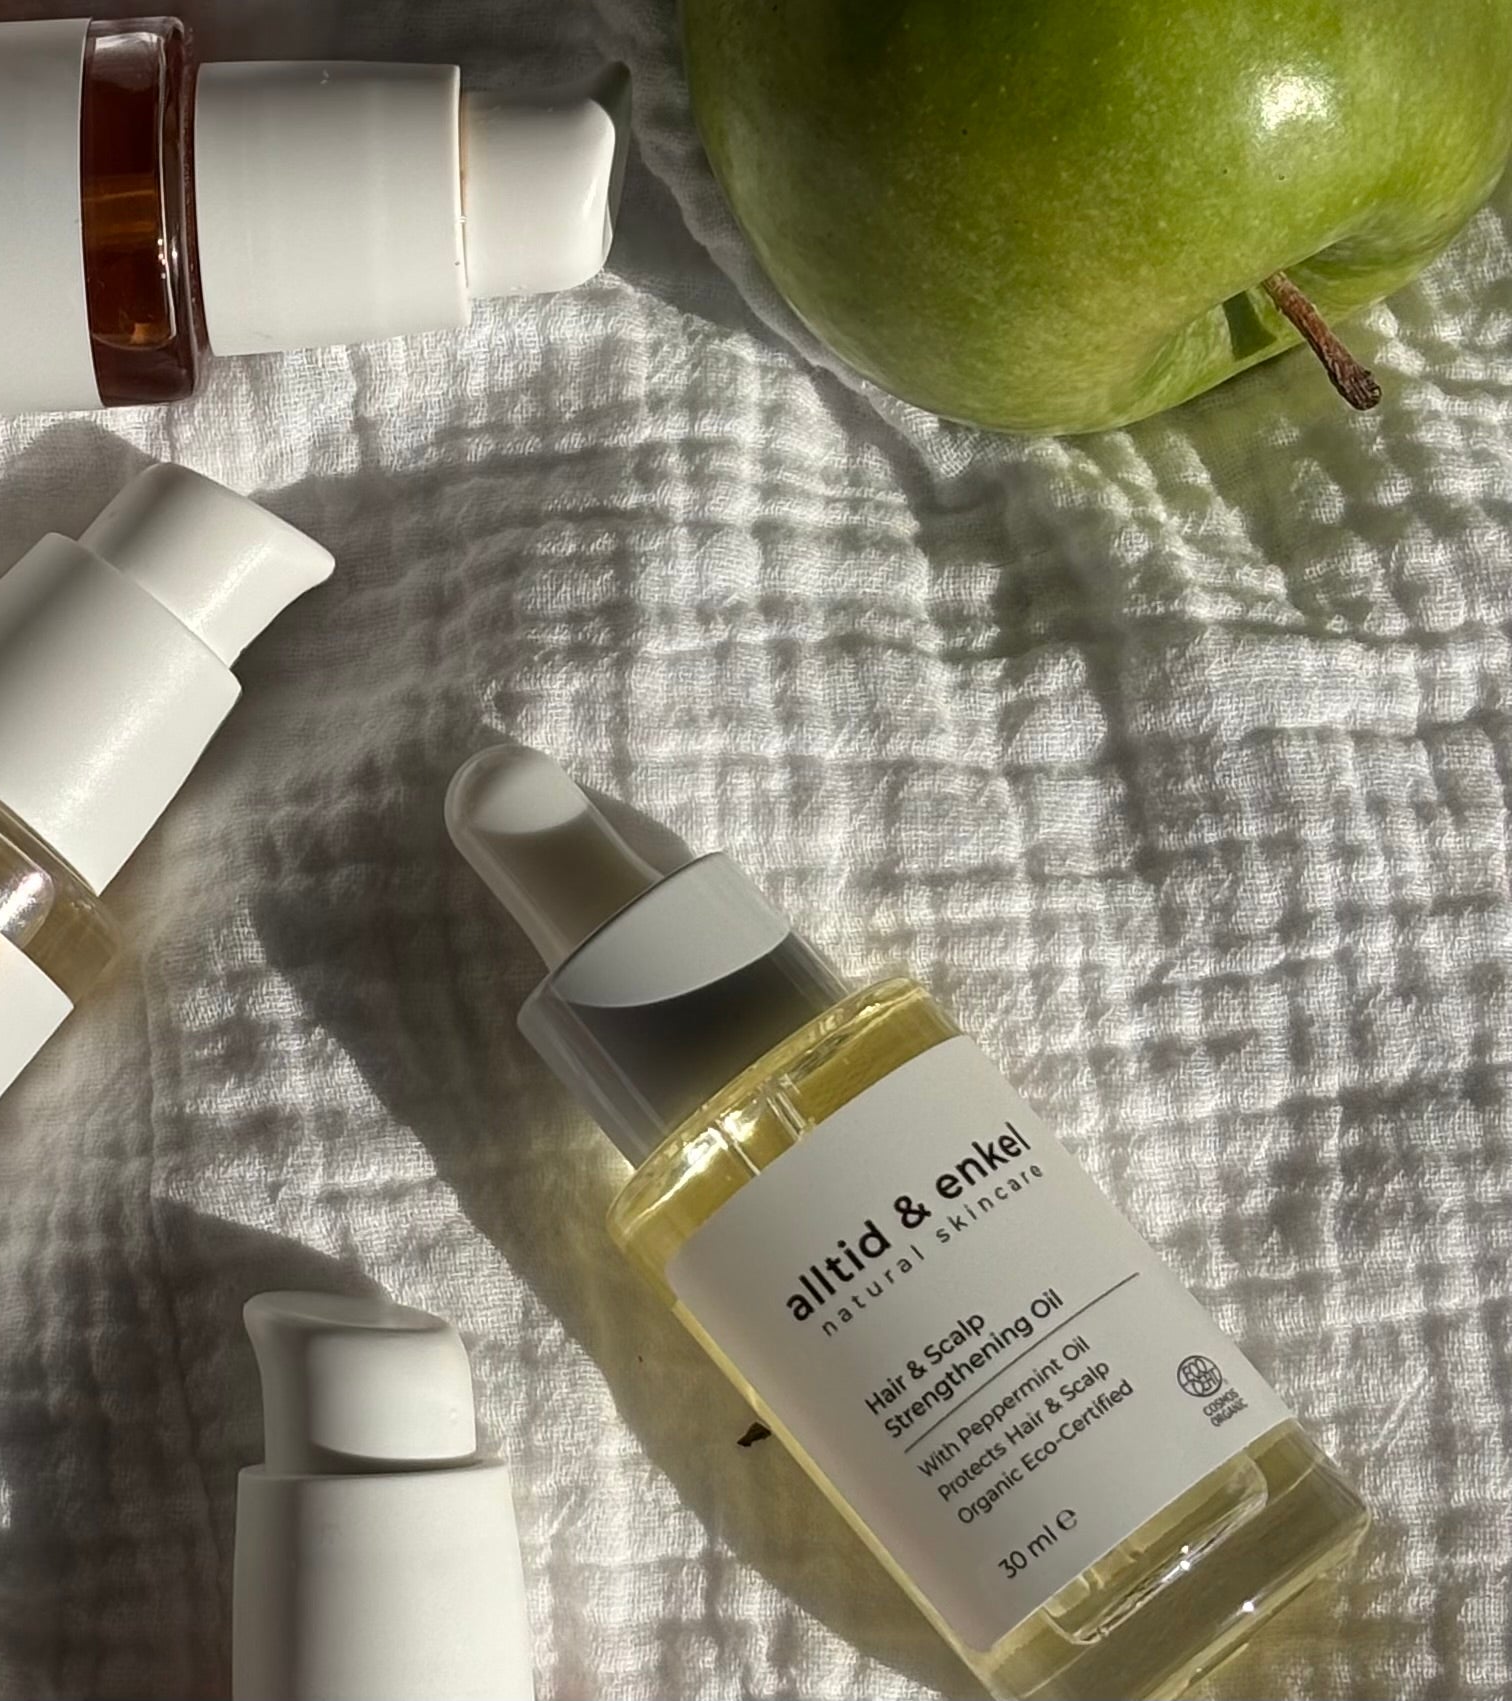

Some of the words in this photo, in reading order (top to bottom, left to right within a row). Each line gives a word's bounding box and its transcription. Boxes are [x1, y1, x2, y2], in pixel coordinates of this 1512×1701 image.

[786, 1219, 891, 1322] alltid
[893, 1194, 932, 1229] &
[935, 1121, 1032, 1201] enkel
[822, 1244, 925, 1337] natural
[936, 1163, 1044, 1244] skincare
[864, 1371, 909, 1416] Hair
[906, 1360, 928, 1382] &
[923, 1311, 986, 1367] Scalp
[884, 1316, 1034, 1438] Strengthening
[1029, 1288, 1064, 1321] Oil
[917, 1437, 960, 1479] With
[957, 1355, 1064, 1447] Peppermint
[1062, 1336, 1091, 1363] Oil
[936, 1441, 1007, 1503] Protects
[1006, 1410, 1047, 1447] Hair
[1044, 1394, 1062, 1413] &
[1059, 1358, 1111, 1404] Scalp
[1203, 1388, 1239, 1416] COSMOS
[957, 1467, 1024, 1525] Organic
[1023, 1379, 1135, 1474] Eco-Certified
[998, 1550, 1029, 1580] 30
[1026, 1525, 1060, 1558] ml
